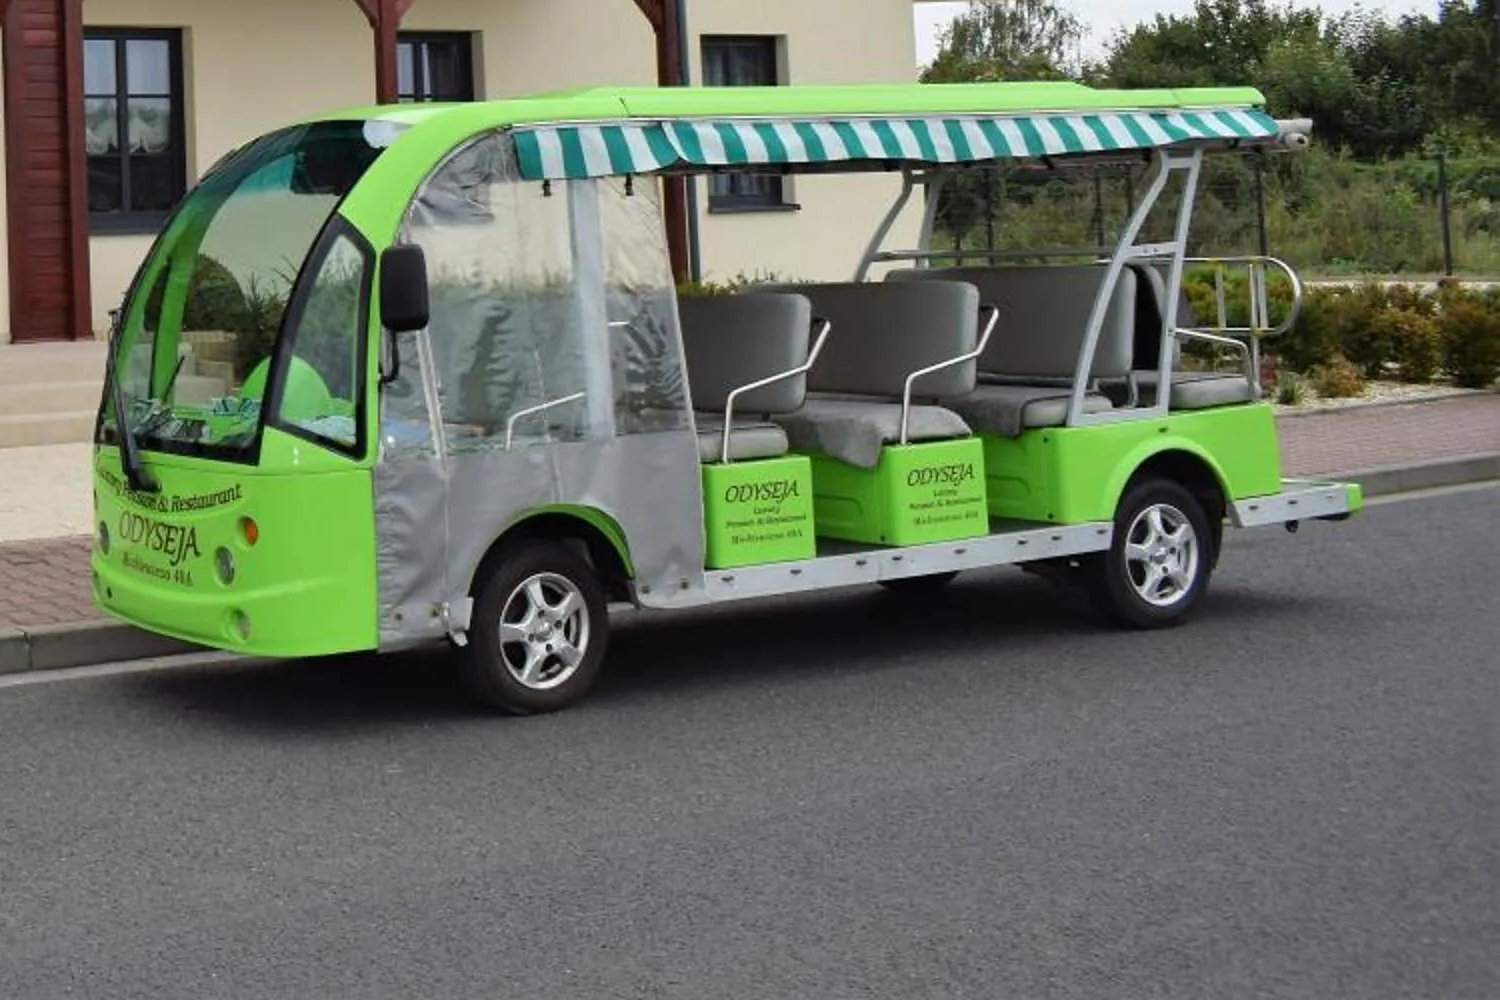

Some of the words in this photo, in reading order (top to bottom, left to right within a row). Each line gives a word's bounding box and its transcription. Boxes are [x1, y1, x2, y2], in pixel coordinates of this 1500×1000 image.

[907, 463, 975, 487] ODYSEJA
[171, 482, 242, 513] Restaurant
[725, 479, 800, 505] ODYSEJA
[119, 510, 202, 566] ODYSEJA
